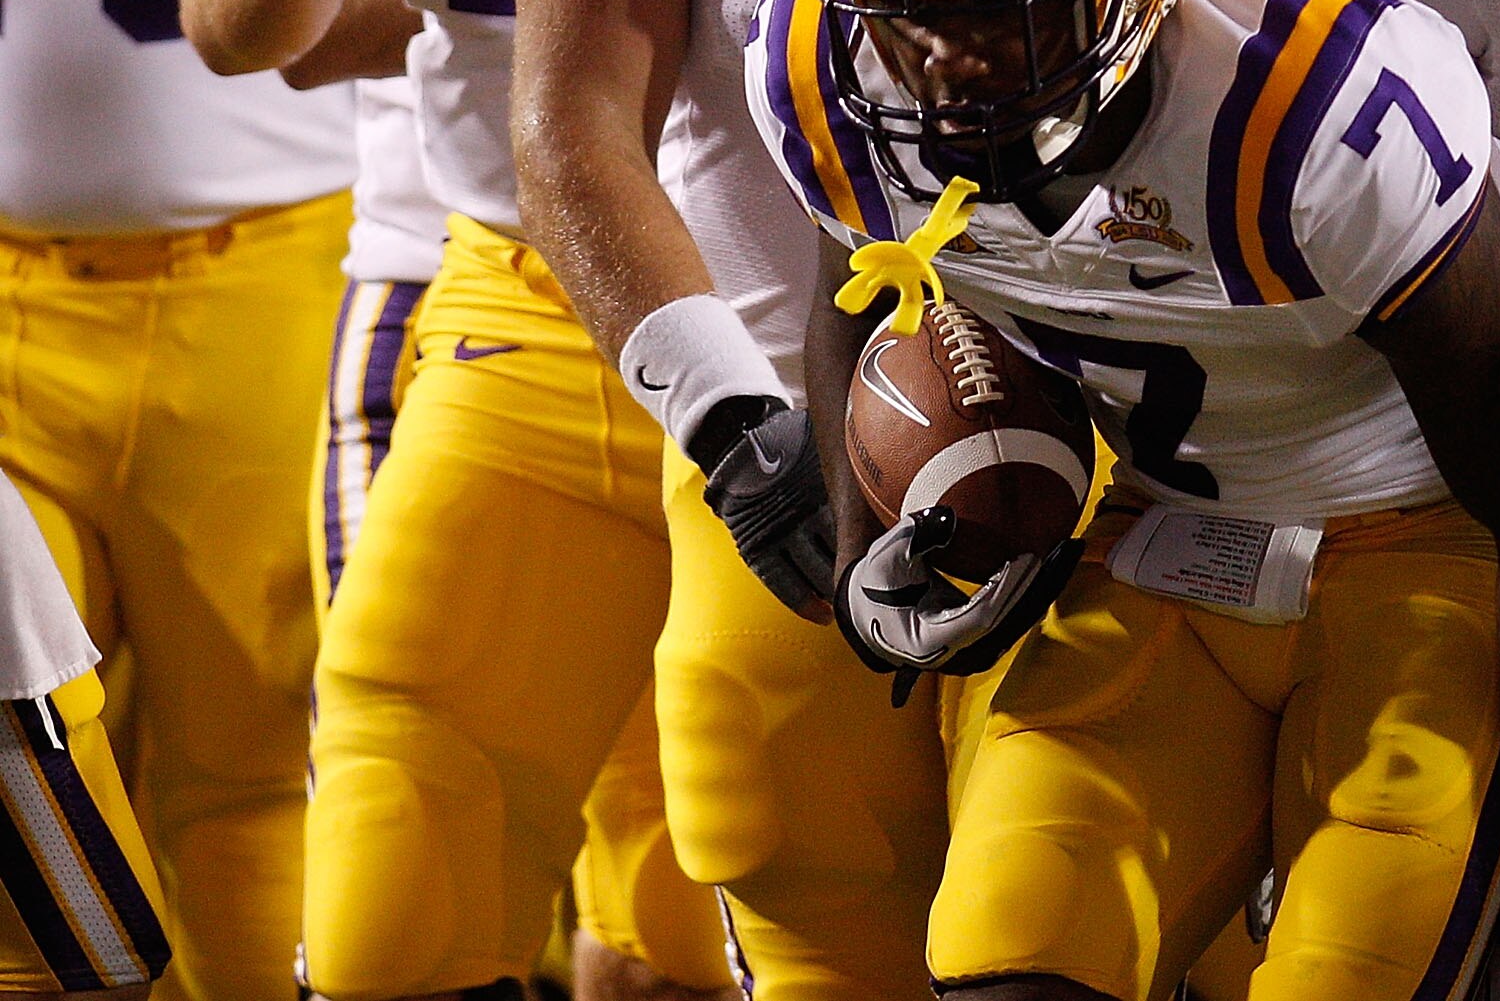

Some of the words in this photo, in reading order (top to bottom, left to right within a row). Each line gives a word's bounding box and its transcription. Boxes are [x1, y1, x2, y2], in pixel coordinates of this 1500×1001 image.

[1122, 186, 1165, 221] 150
[1341, 67, 1473, 208] 7
[1004, 310, 1220, 501] 7
